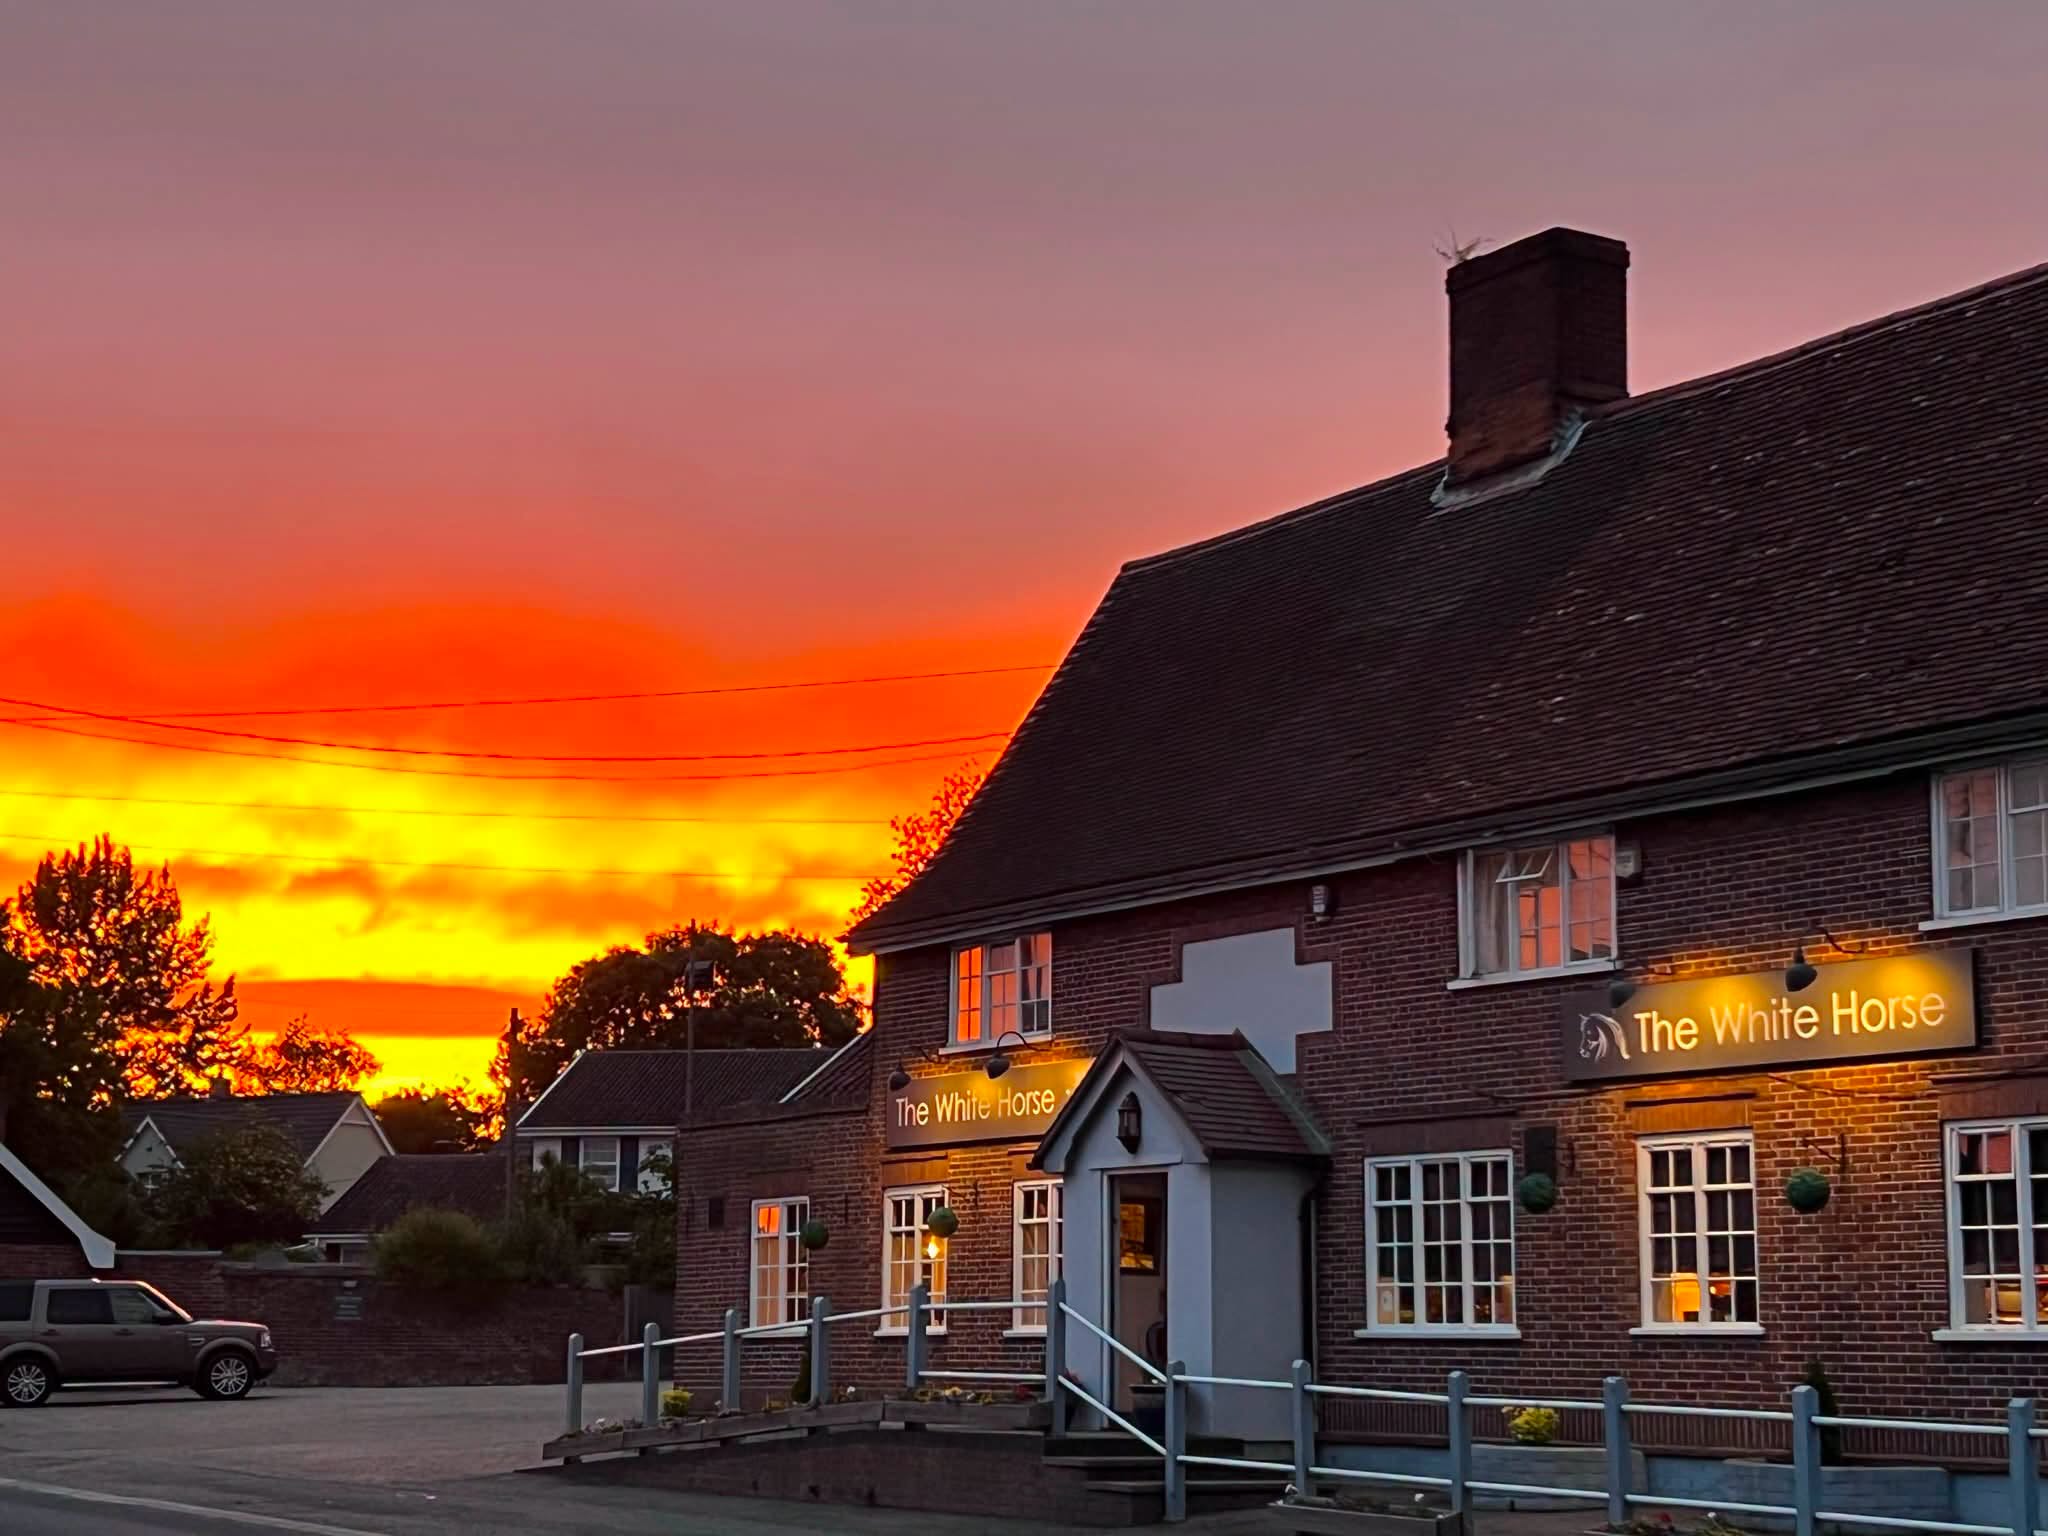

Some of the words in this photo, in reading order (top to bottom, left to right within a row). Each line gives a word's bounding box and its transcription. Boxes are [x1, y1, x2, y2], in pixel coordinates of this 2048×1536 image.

[1634, 1010, 1699, 1053] The
[1710, 999, 1818, 1044] White
[1831, 990, 1945, 1034] Horse
[896, 1098, 929, 1127] The
[935, 1089, 991, 1122] White
[998, 1088, 1055, 1117] Horse
